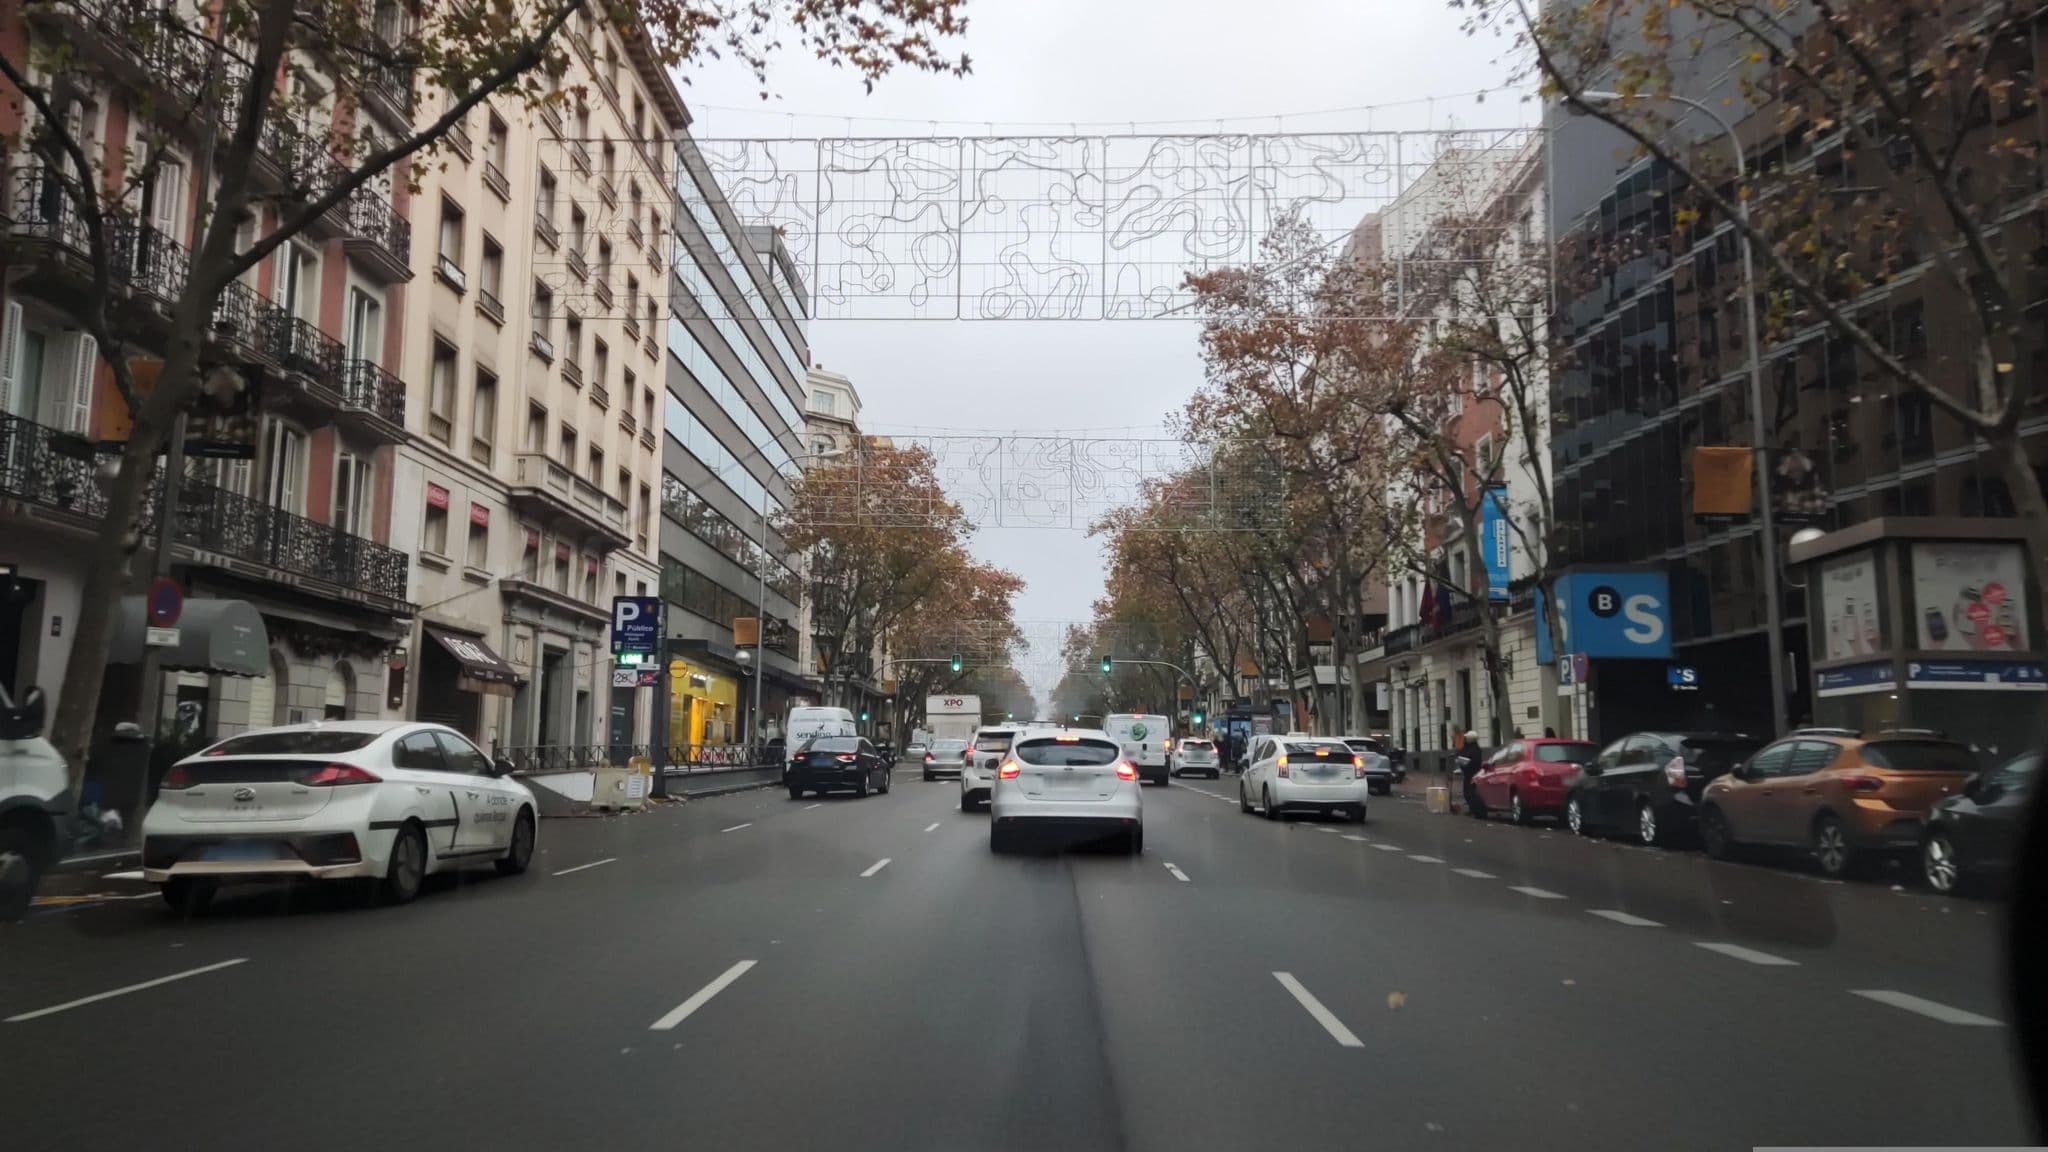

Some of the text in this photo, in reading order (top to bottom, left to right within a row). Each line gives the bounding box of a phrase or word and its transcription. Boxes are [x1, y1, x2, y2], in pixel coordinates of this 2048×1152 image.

[616, 602, 639, 631] P
[1598, 594, 1664, 644] B S
[626, 624, 654, 632] Público
[1682, 669, 1695, 682] S
[944, 699, 963, 707] XPO
